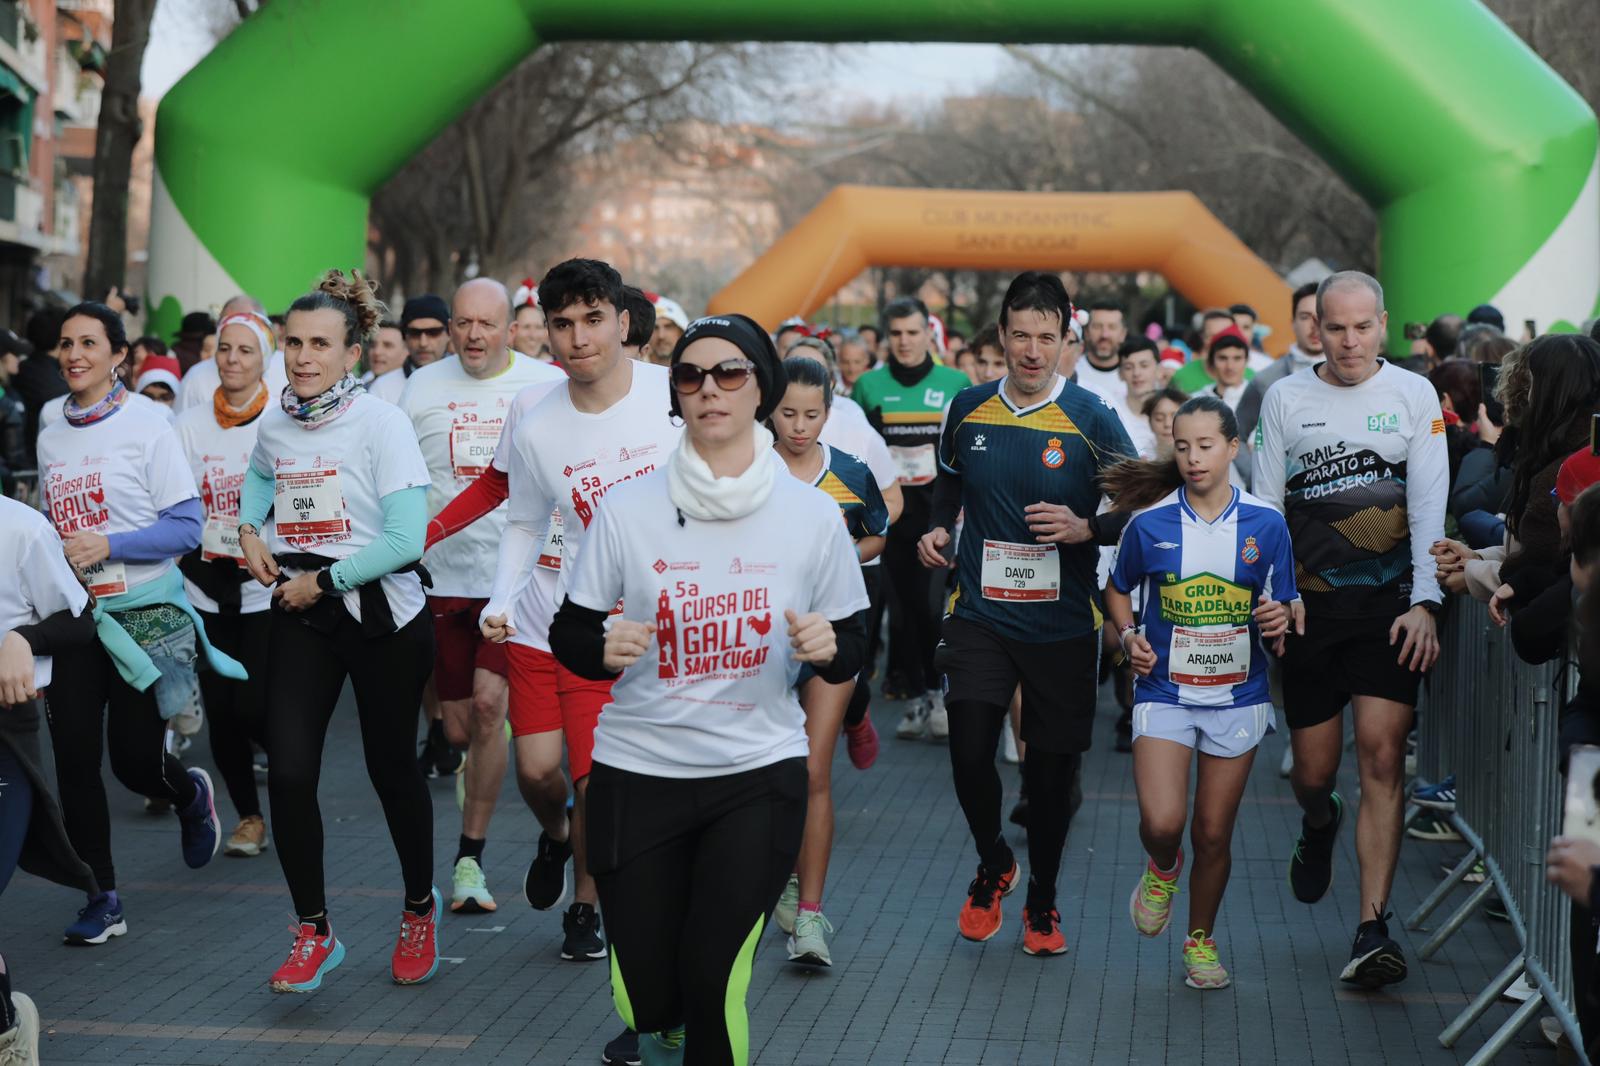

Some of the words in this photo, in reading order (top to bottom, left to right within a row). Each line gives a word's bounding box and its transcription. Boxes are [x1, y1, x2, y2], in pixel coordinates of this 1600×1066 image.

[469, 446, 495, 457] EDUA
[1298, 440, 1347, 470] TRAILS
[1304, 449, 1359, 484] MARATÓ
[1363, 455, 1377, 466] DE
[53, 477, 83, 500] CURSA
[86, 472, 103, 490] DEL
[582, 475, 602, 492] 5a
[1304, 467, 1393, 500] COLLSEROLA
[54, 492, 93, 523] GALL
[293, 497, 316, 510] GINA
[81, 508, 109, 529] CUGAT
[300, 511, 310, 521] 967
[336, 533, 352, 543] 2025
[551, 533, 564, 546] AR
[1005, 567, 1035, 579] DAVID
[675, 580, 699, 599] 5a
[1014, 580, 1026, 588] 729
[1185, 585, 1226, 598] GRUP
[682, 592, 738, 623] CURSA
[743, 587, 771, 612] DEL
[1162, 595, 1249, 614] TARRADELLAS
[1162, 612, 1195, 625] PRESTIGI
[683, 617, 747, 655] GALL
[685, 654, 721, 677] SANT
[722, 646, 771, 670] CUGAT
[1186, 652, 1235, 666] ARIADNA
[1204, 666, 1217, 675] 730
